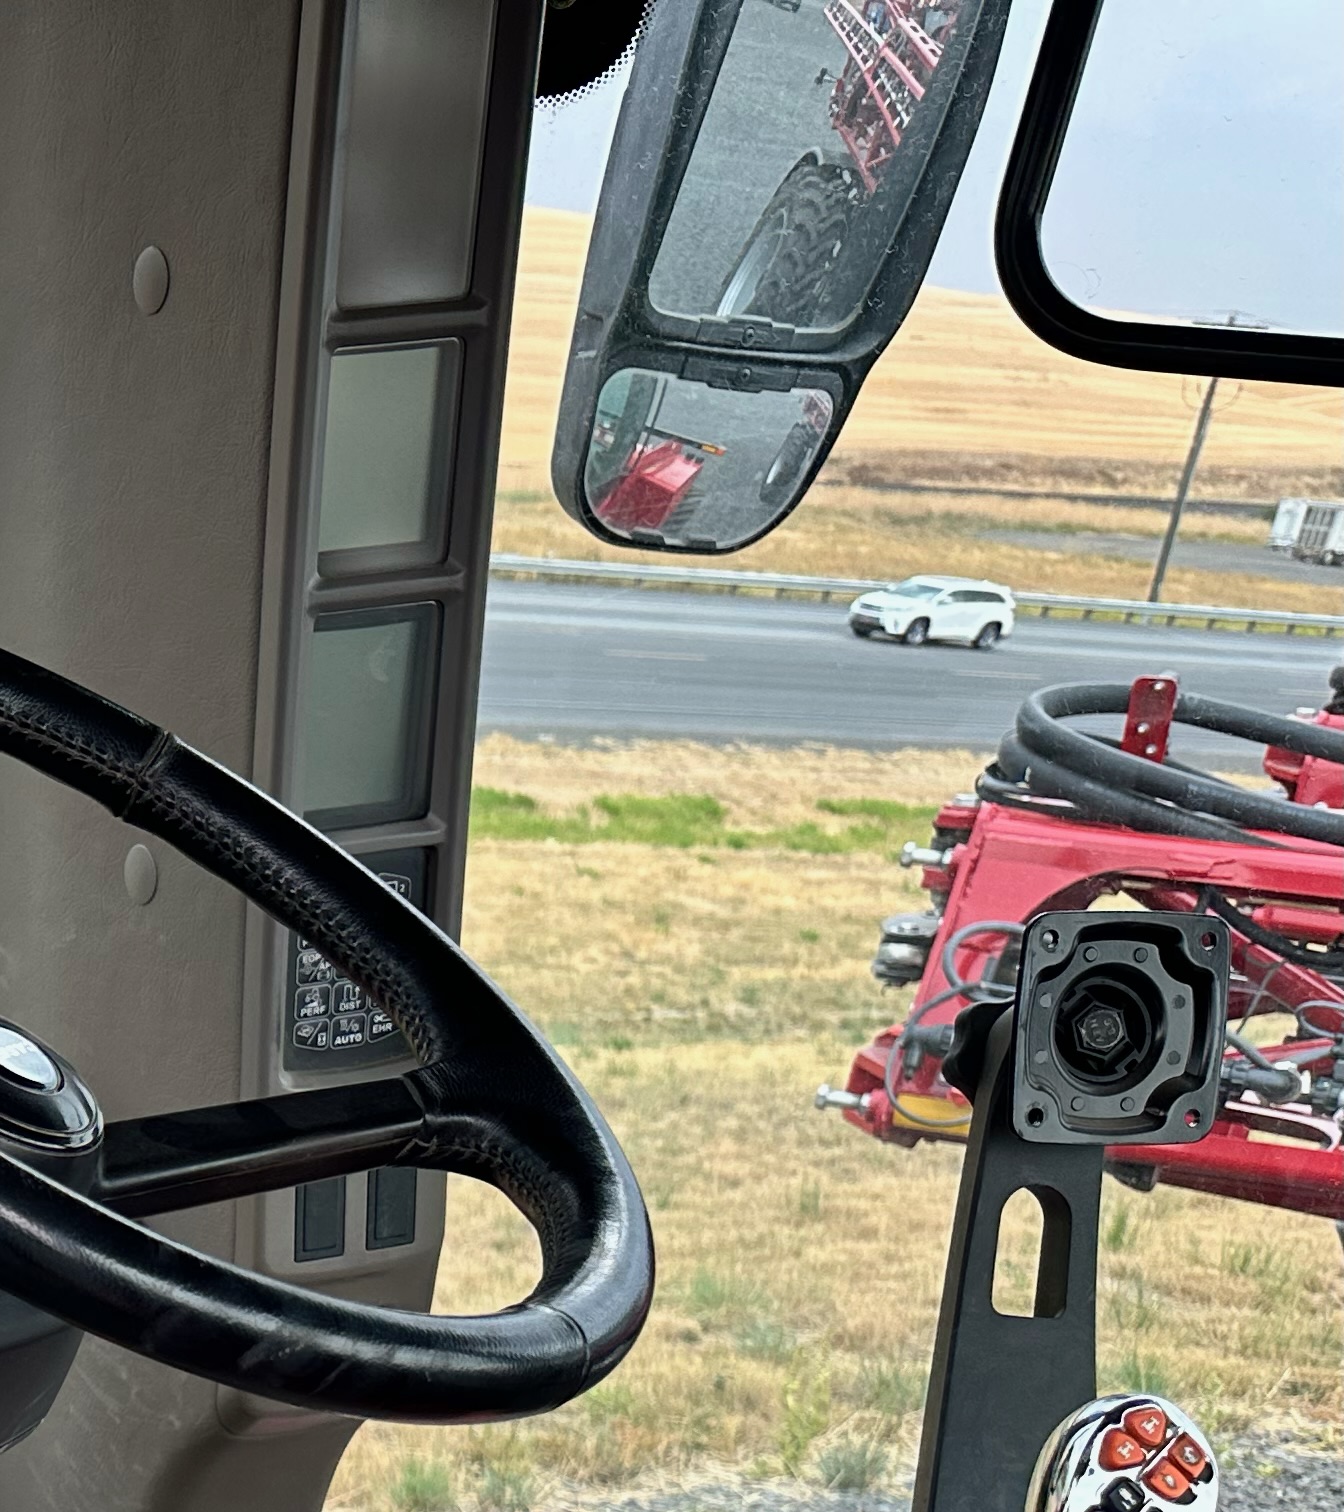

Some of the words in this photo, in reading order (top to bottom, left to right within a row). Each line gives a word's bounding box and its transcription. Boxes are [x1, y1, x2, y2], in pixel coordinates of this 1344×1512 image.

[300, 1005, 326, 1018] PERF
[339, 1000, 361, 1012] DIST
[334, 1032, 362, 1046] AUTO
